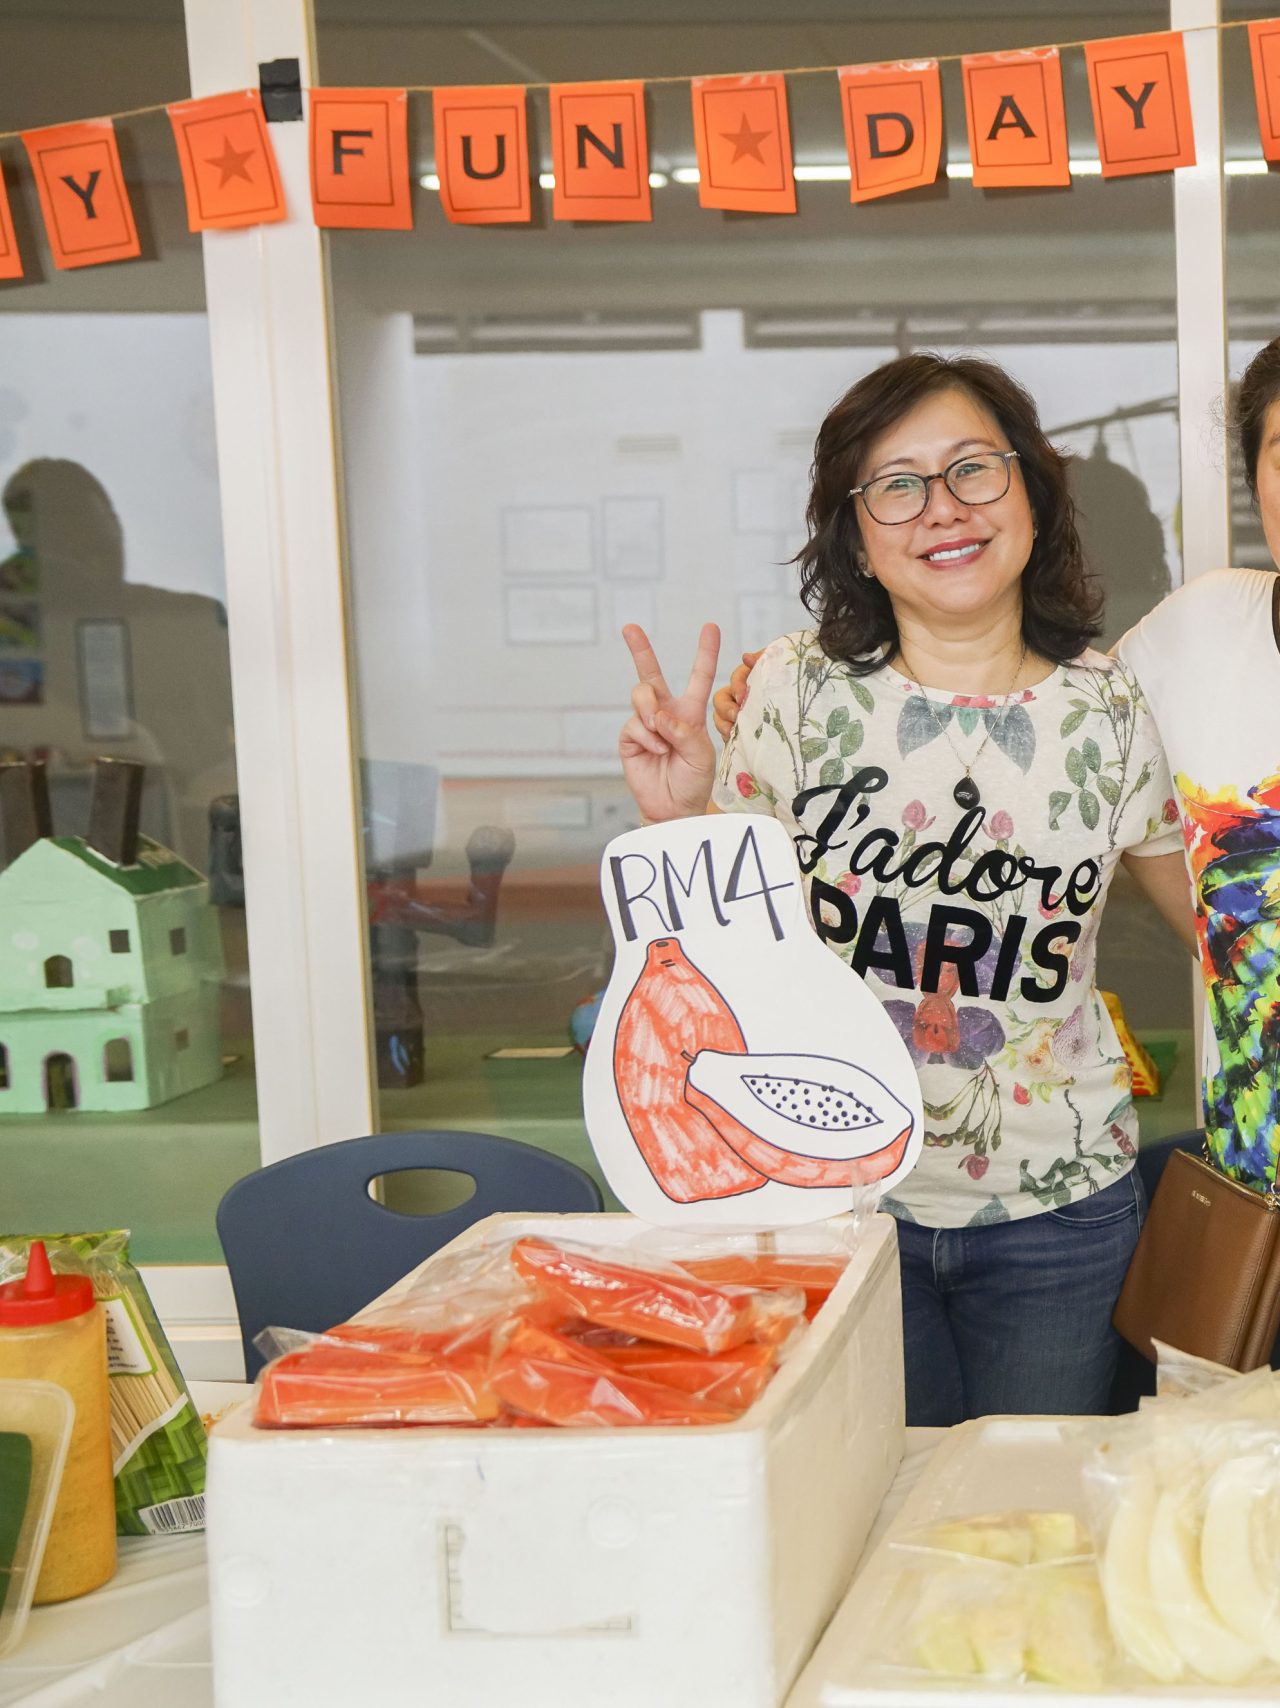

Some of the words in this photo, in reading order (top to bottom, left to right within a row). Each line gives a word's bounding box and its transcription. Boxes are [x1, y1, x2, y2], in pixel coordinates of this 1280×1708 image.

[331, 123, 626, 180] FUN
[865, 81, 1158, 159] DAY
[609, 825, 795, 942] RM4
[792, 766, 1101, 916] J'adore
[811, 876, 1082, 1003] PARIS
